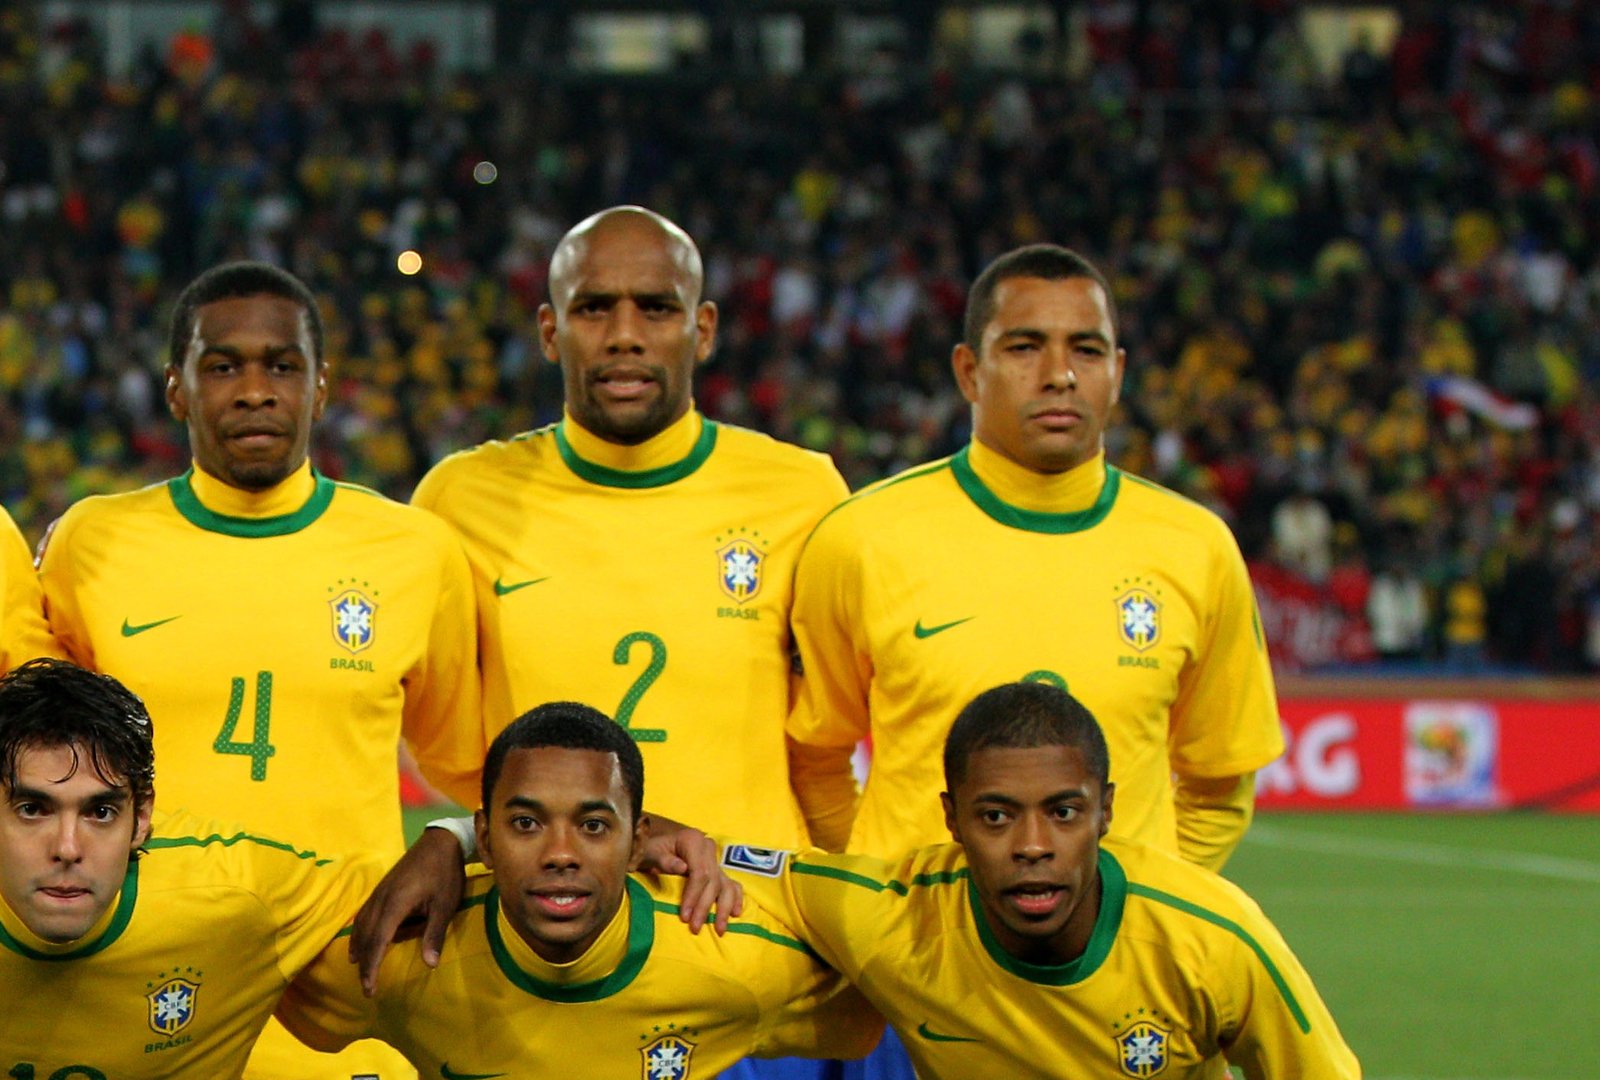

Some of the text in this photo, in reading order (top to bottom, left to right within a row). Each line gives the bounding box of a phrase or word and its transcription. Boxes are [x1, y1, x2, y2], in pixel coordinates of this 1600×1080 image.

[717, 607, 760, 621] BRASIL
[329, 657, 376, 673] BRASIL
[1117, 655, 1160, 670] BRASIL
[613, 631, 668, 743] 2
[212, 670, 276, 782] 4
[144, 1035, 193, 1054] BRASIL
[658, 1058, 677, 1068] CBF
